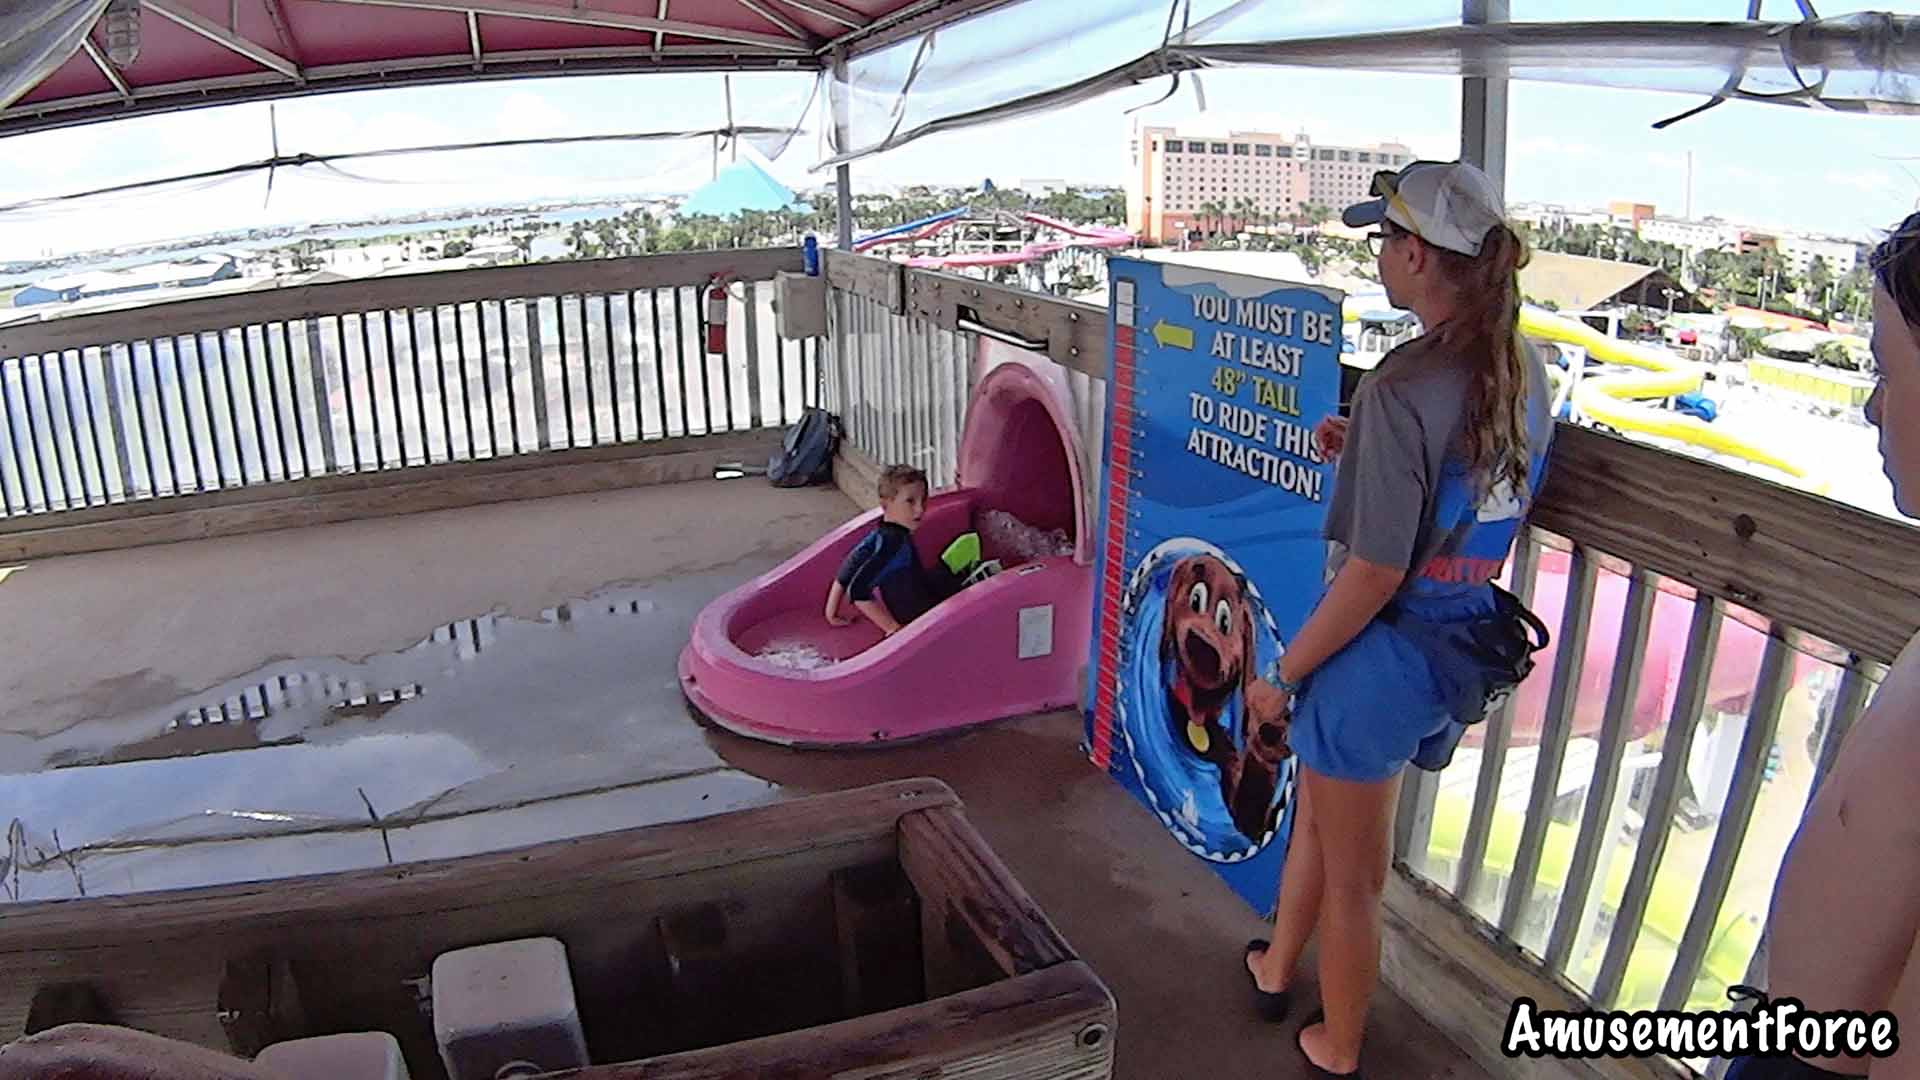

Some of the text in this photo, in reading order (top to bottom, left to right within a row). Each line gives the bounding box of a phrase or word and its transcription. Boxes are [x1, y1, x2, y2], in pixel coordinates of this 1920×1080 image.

[1192, 293, 1333, 346] YOU MUST BE
[1211, 331, 1303, 378] AT LEAST
[1252, 375, 1301, 416] TALL
[1189, 392, 1323, 465] TO RIDE THIS
[1187, 428, 1322, 502] ATTRACTION!
